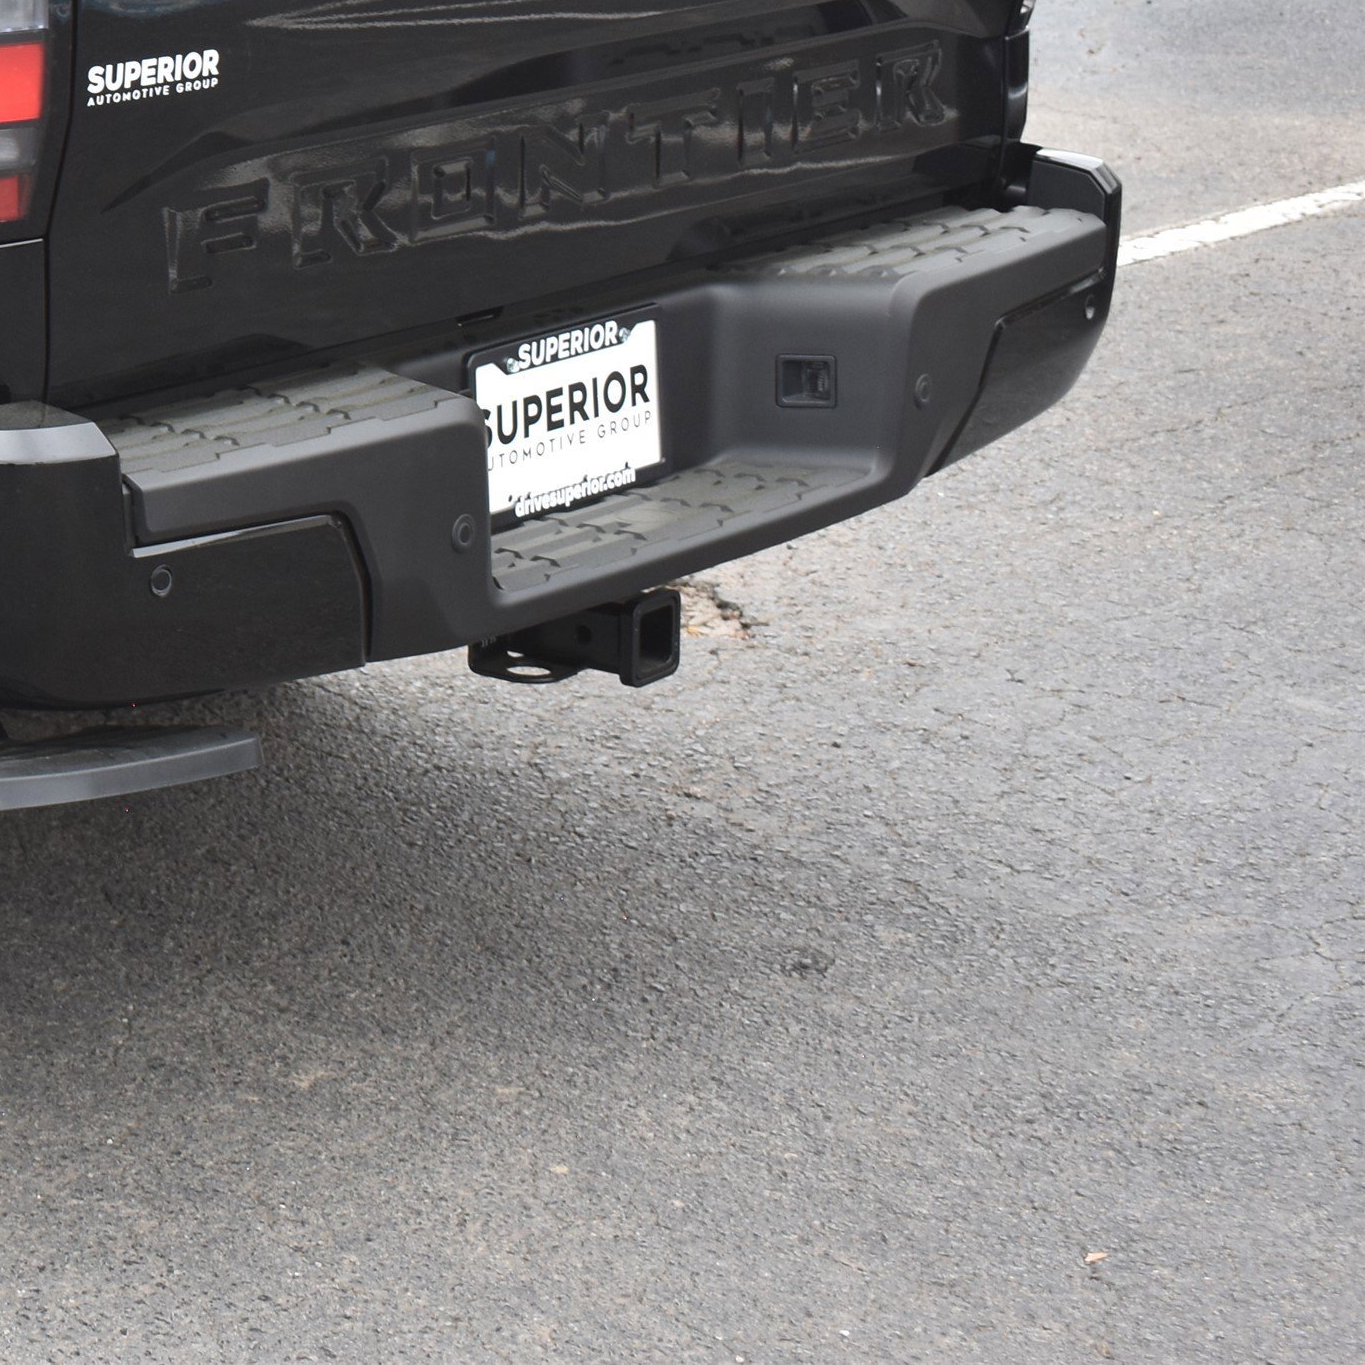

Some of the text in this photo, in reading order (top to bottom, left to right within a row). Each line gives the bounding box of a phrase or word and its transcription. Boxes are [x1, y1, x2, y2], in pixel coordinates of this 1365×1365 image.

[87, 49, 220, 94] SUPERIOR
[87, 77, 219, 107] AUTOMOTIVE GROUP
[164, 42, 953, 292] FRONTIER
[517, 319, 619, 370] SUPERIOR
[488, 410, 652, 472] UTOMOTIVE GROUP
[515, 466, 636, 517] drivesuperior.com
